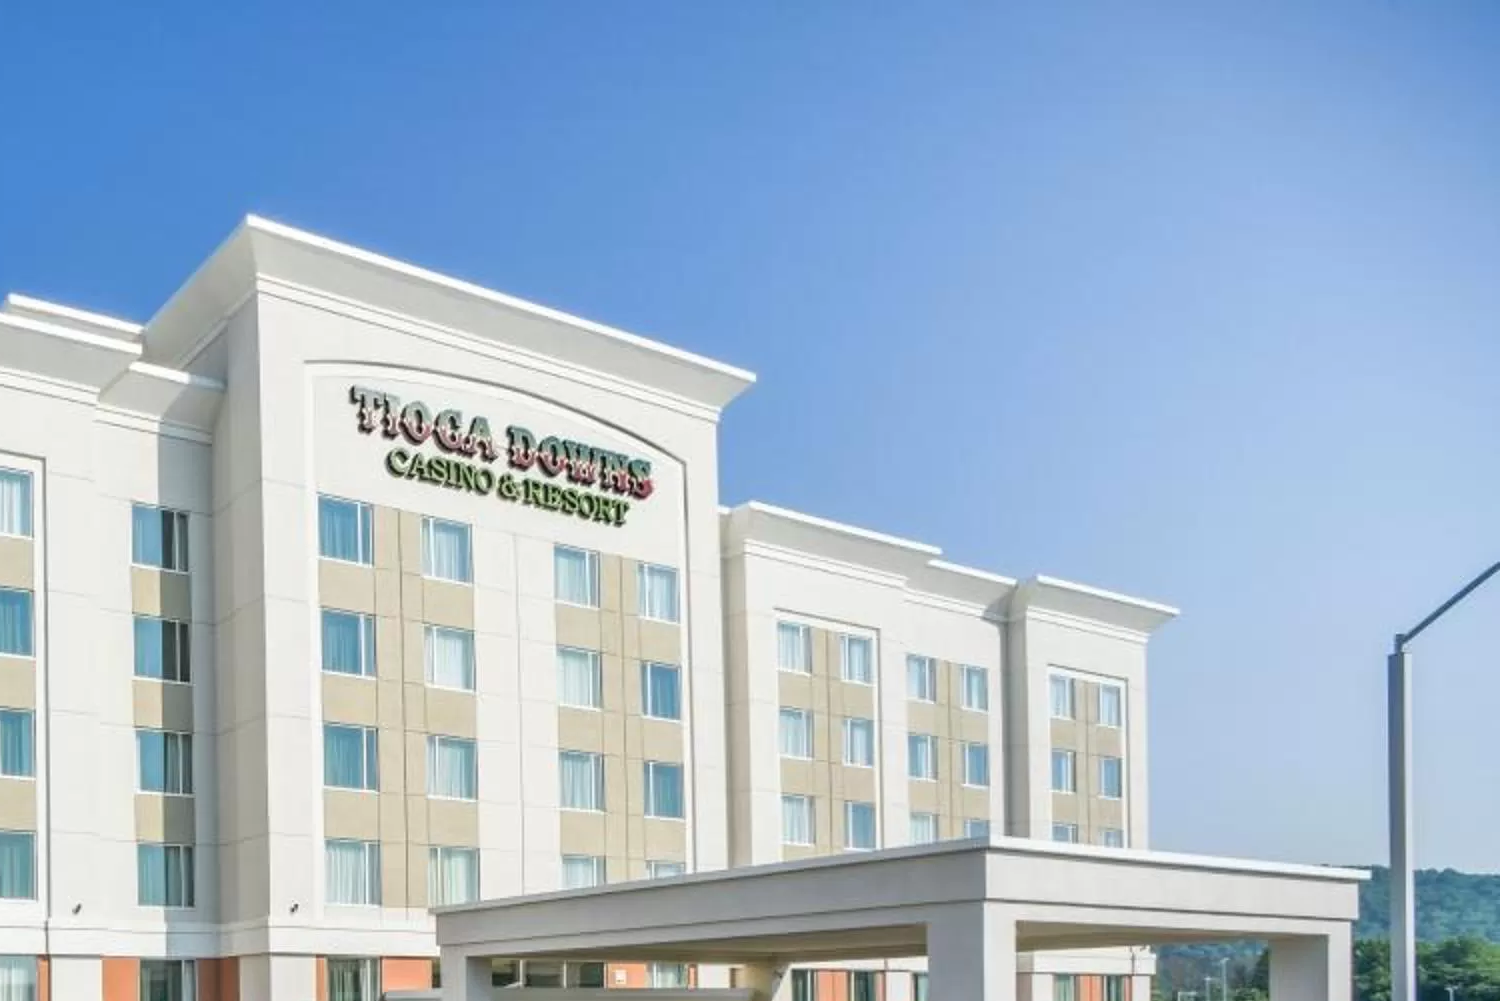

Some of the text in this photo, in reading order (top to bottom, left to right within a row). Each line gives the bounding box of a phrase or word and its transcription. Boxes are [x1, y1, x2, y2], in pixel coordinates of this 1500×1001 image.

[350, 385, 654, 499] TIOGA DOWNS
[385, 447, 631, 527] CASINO & RESORT
